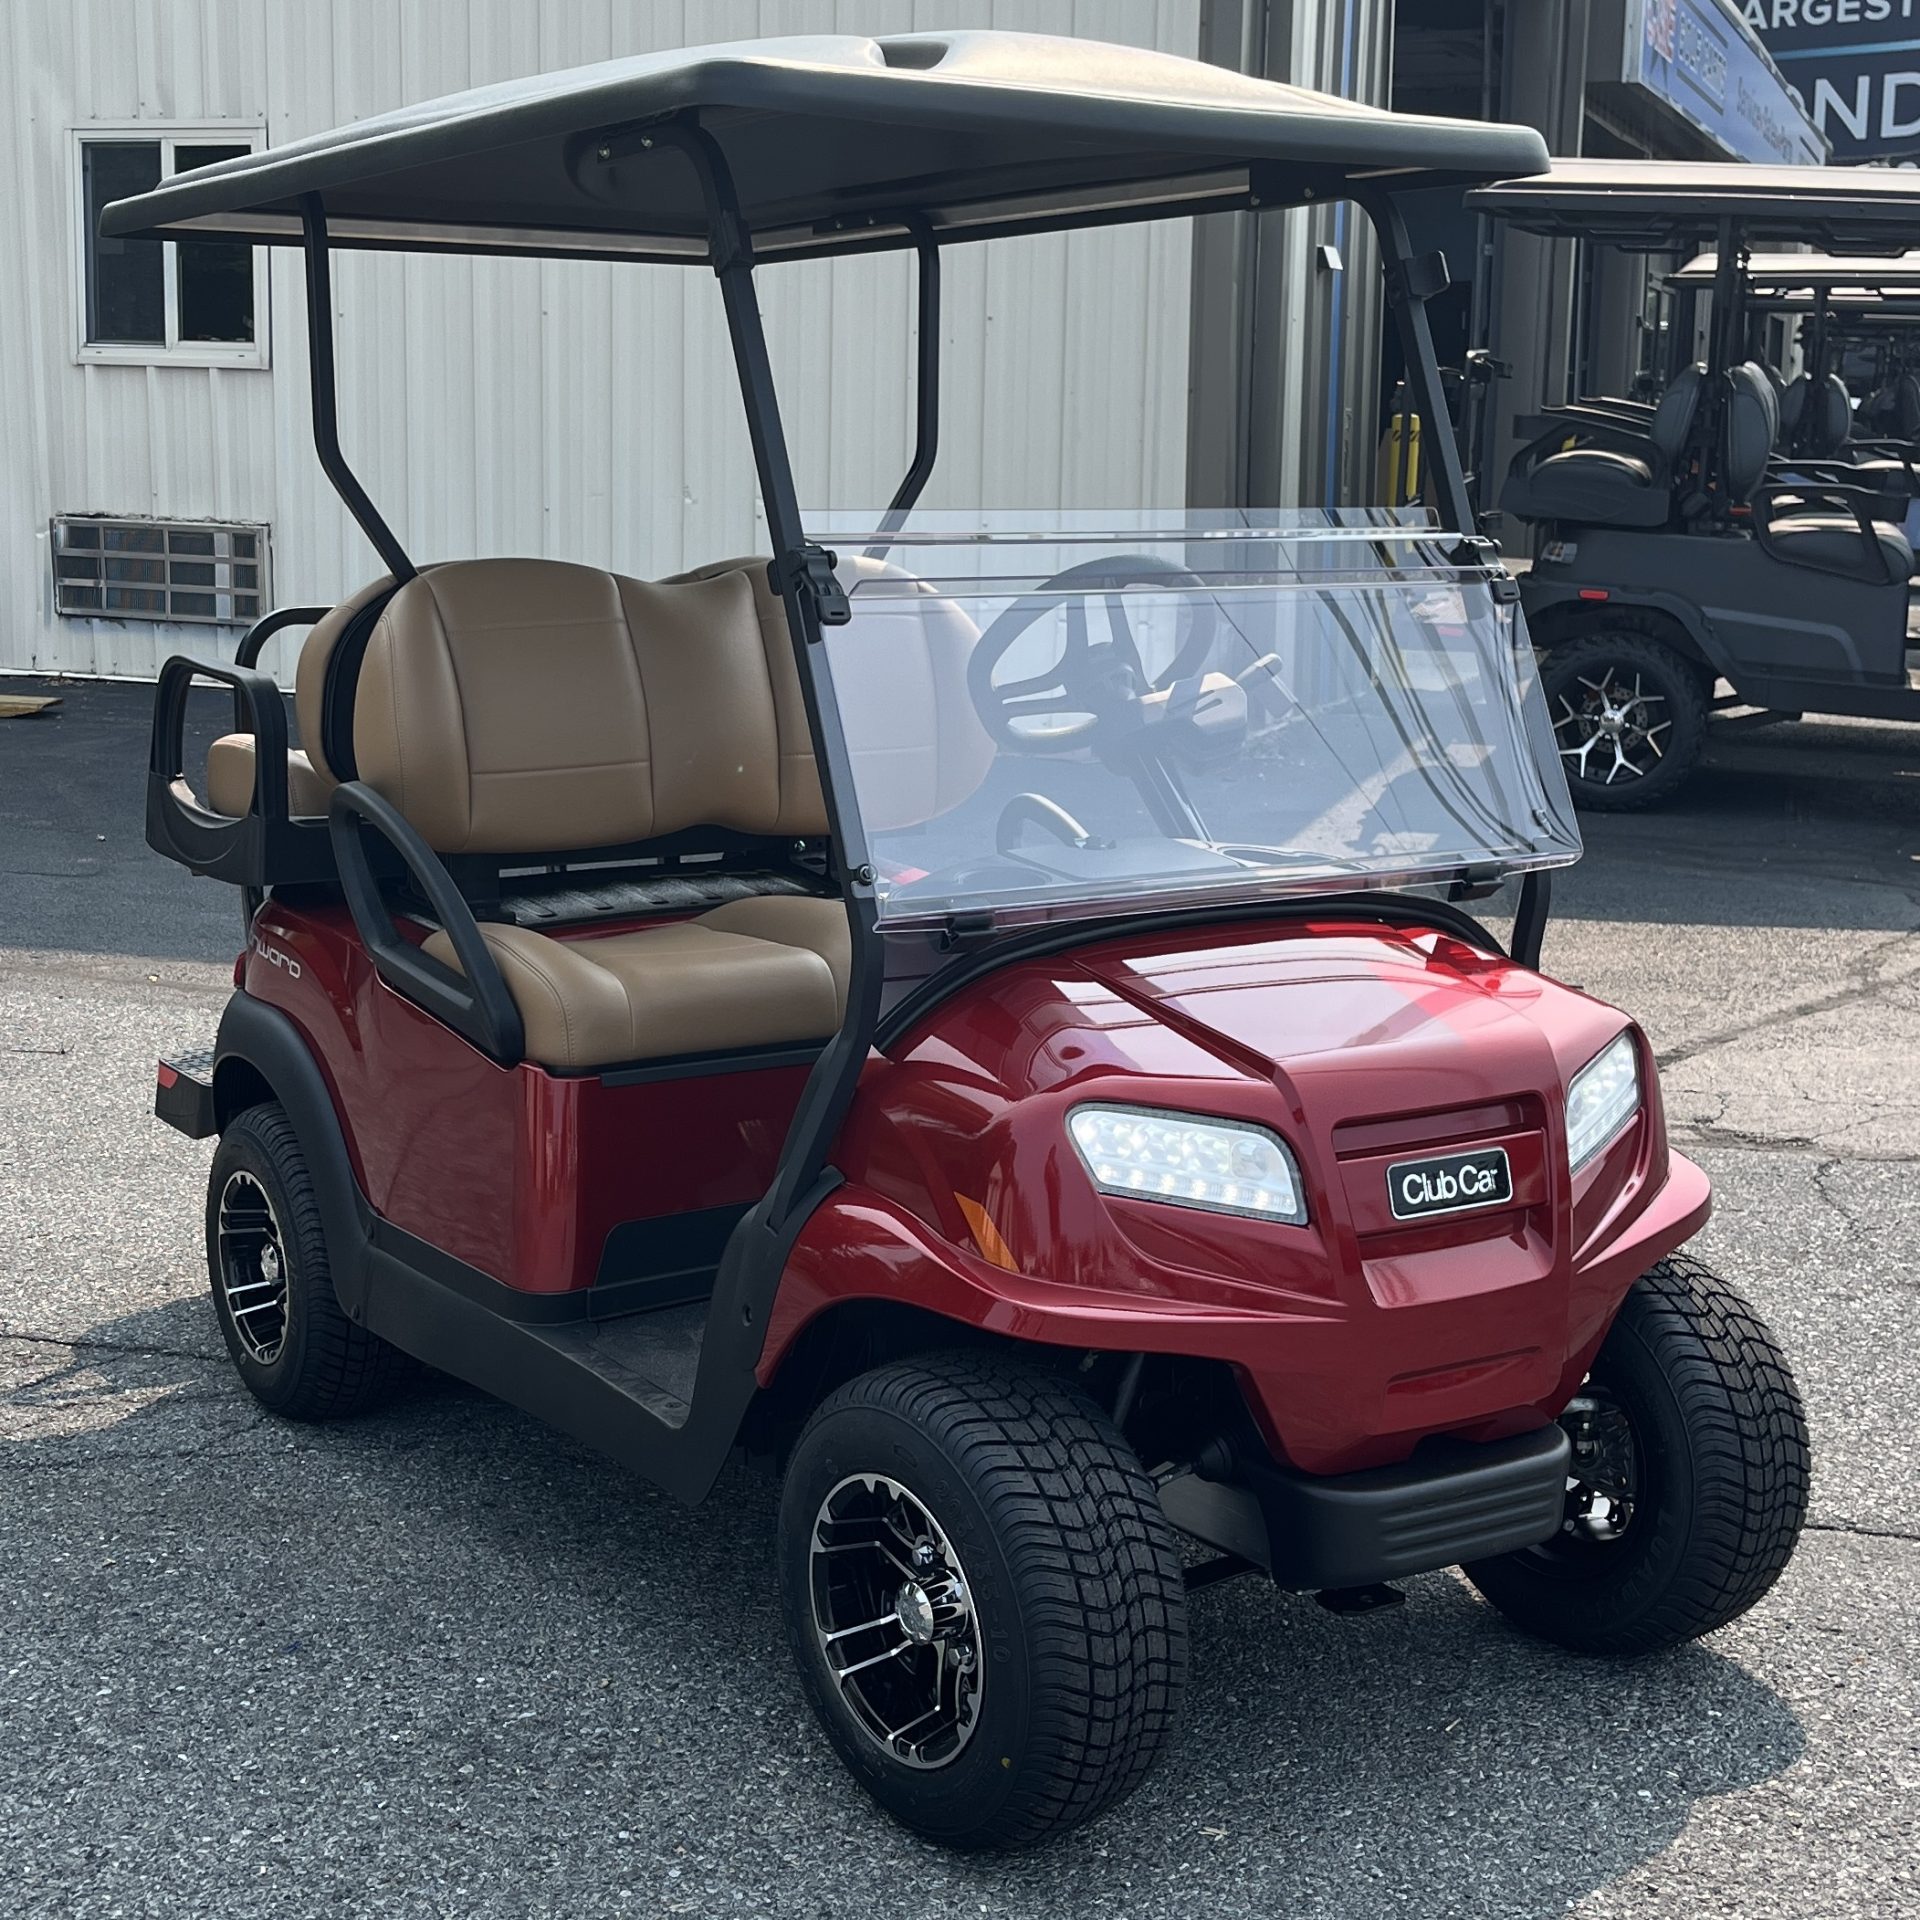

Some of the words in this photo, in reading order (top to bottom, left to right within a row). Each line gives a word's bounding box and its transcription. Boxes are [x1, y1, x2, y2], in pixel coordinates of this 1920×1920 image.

[1786, 72, 1920, 140] ND
[1402, 1170, 1458, 1204] Club
[1458, 1164, 1498, 1195] Car
